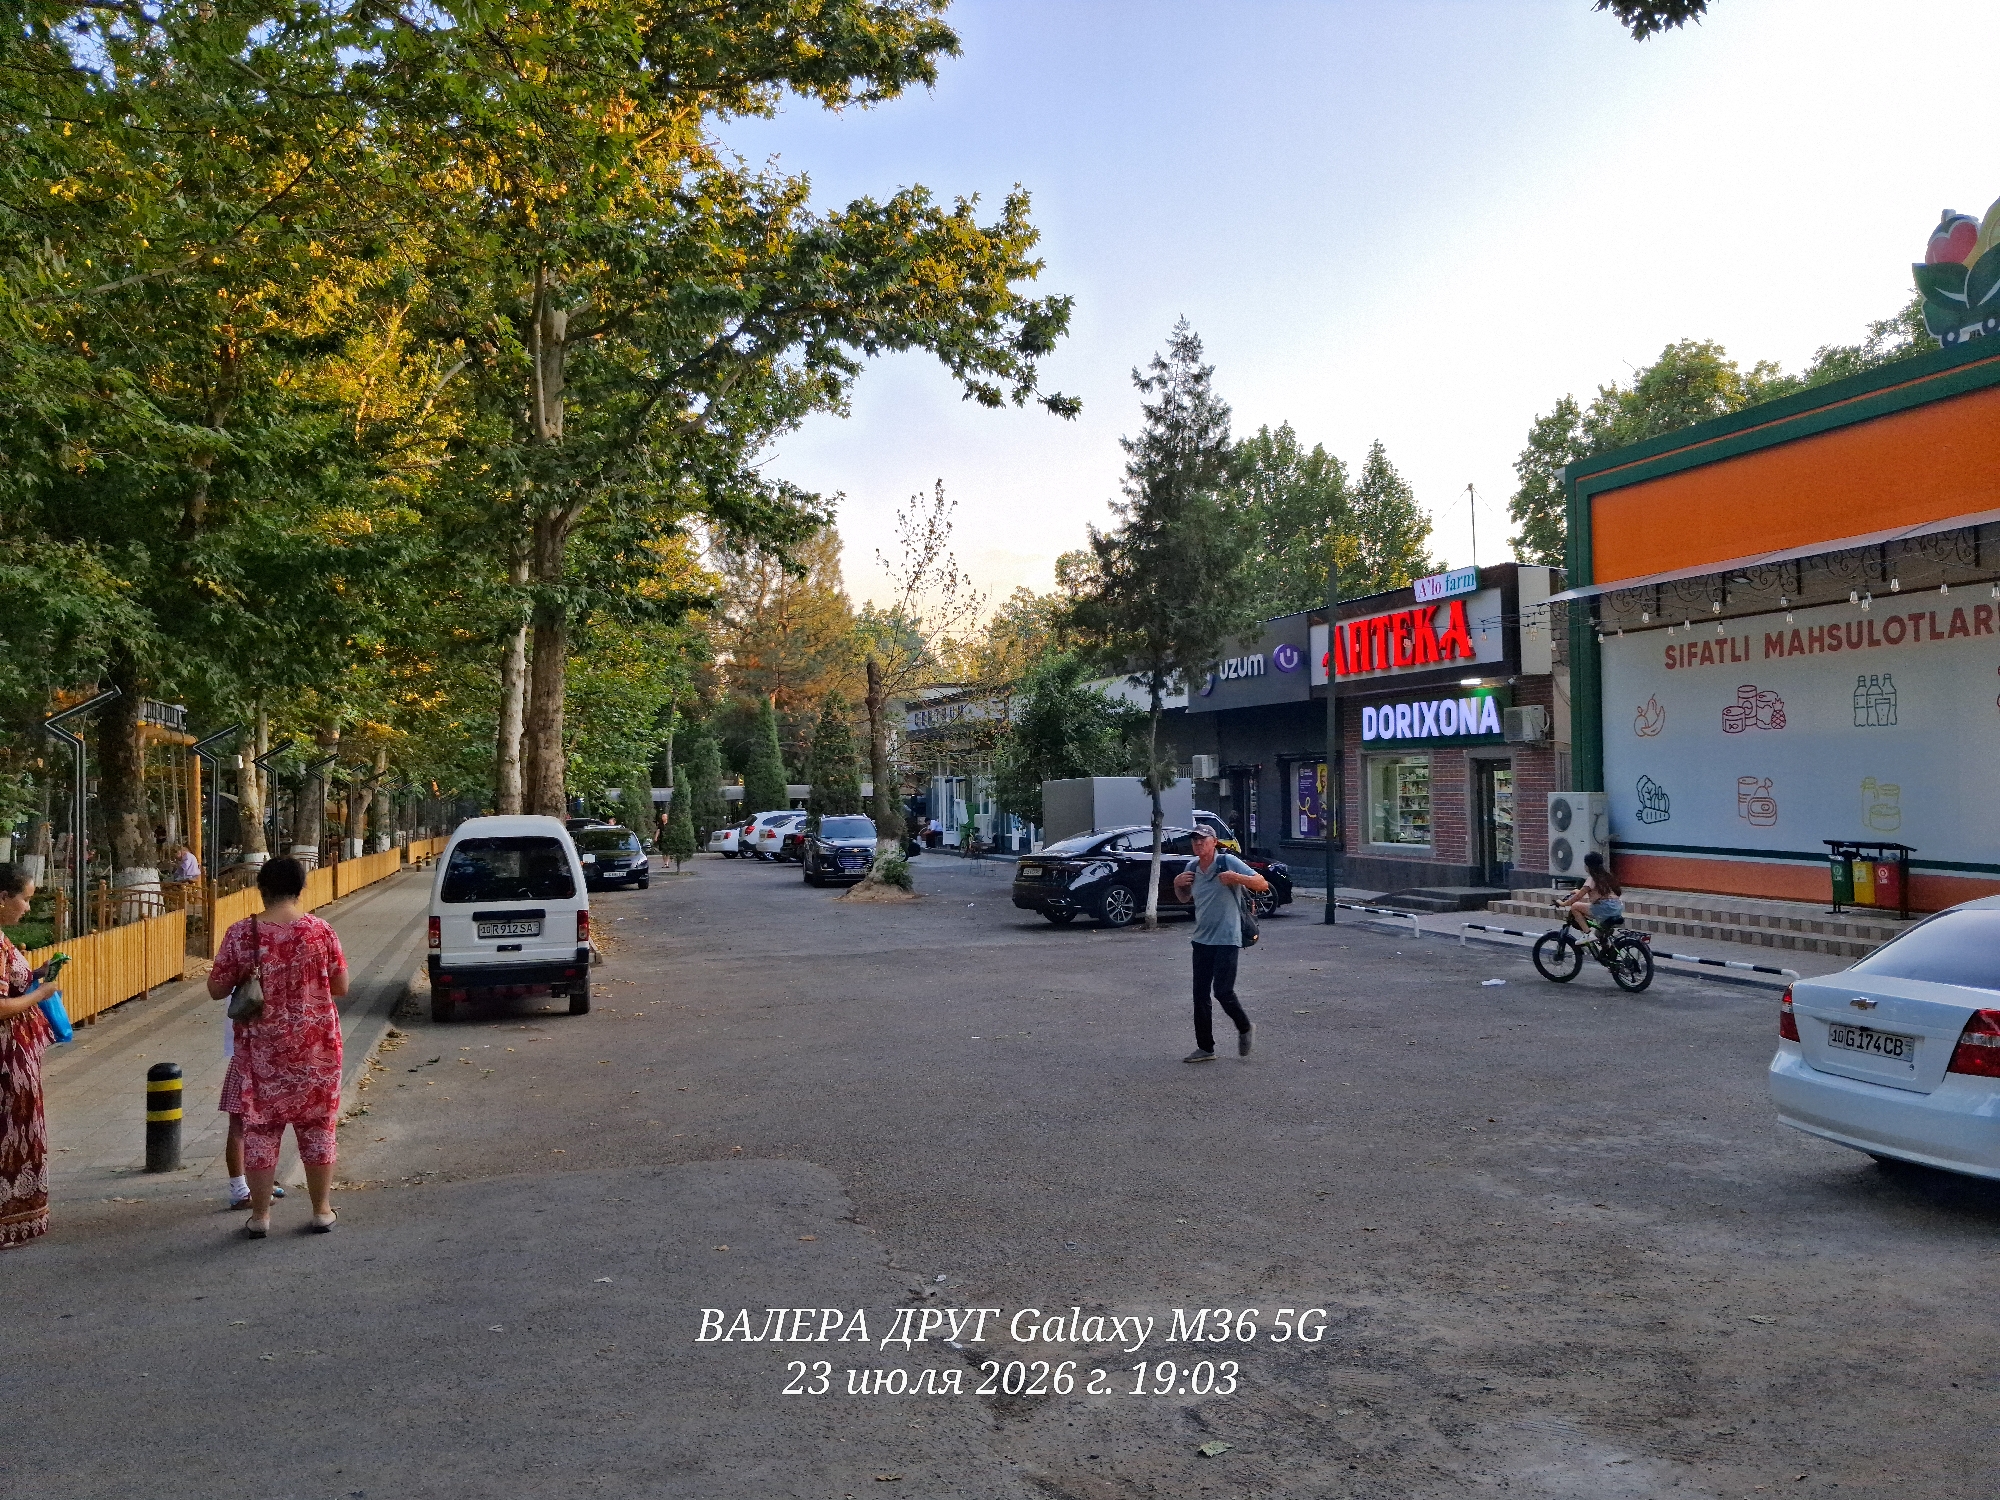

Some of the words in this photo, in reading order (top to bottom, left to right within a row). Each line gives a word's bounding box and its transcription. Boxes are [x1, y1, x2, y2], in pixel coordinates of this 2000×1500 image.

[1417, 579, 1442, 599] A'lo
[1444, 572, 1475, 593] farm
[1321, 599, 1476, 676] АПТЕКА
[1664, 634, 1750, 670] SIFATLI
[1764, 602, 2000, 660] MAHSULOTLAR
[1362, 695, 1500, 741] DORIXONA
